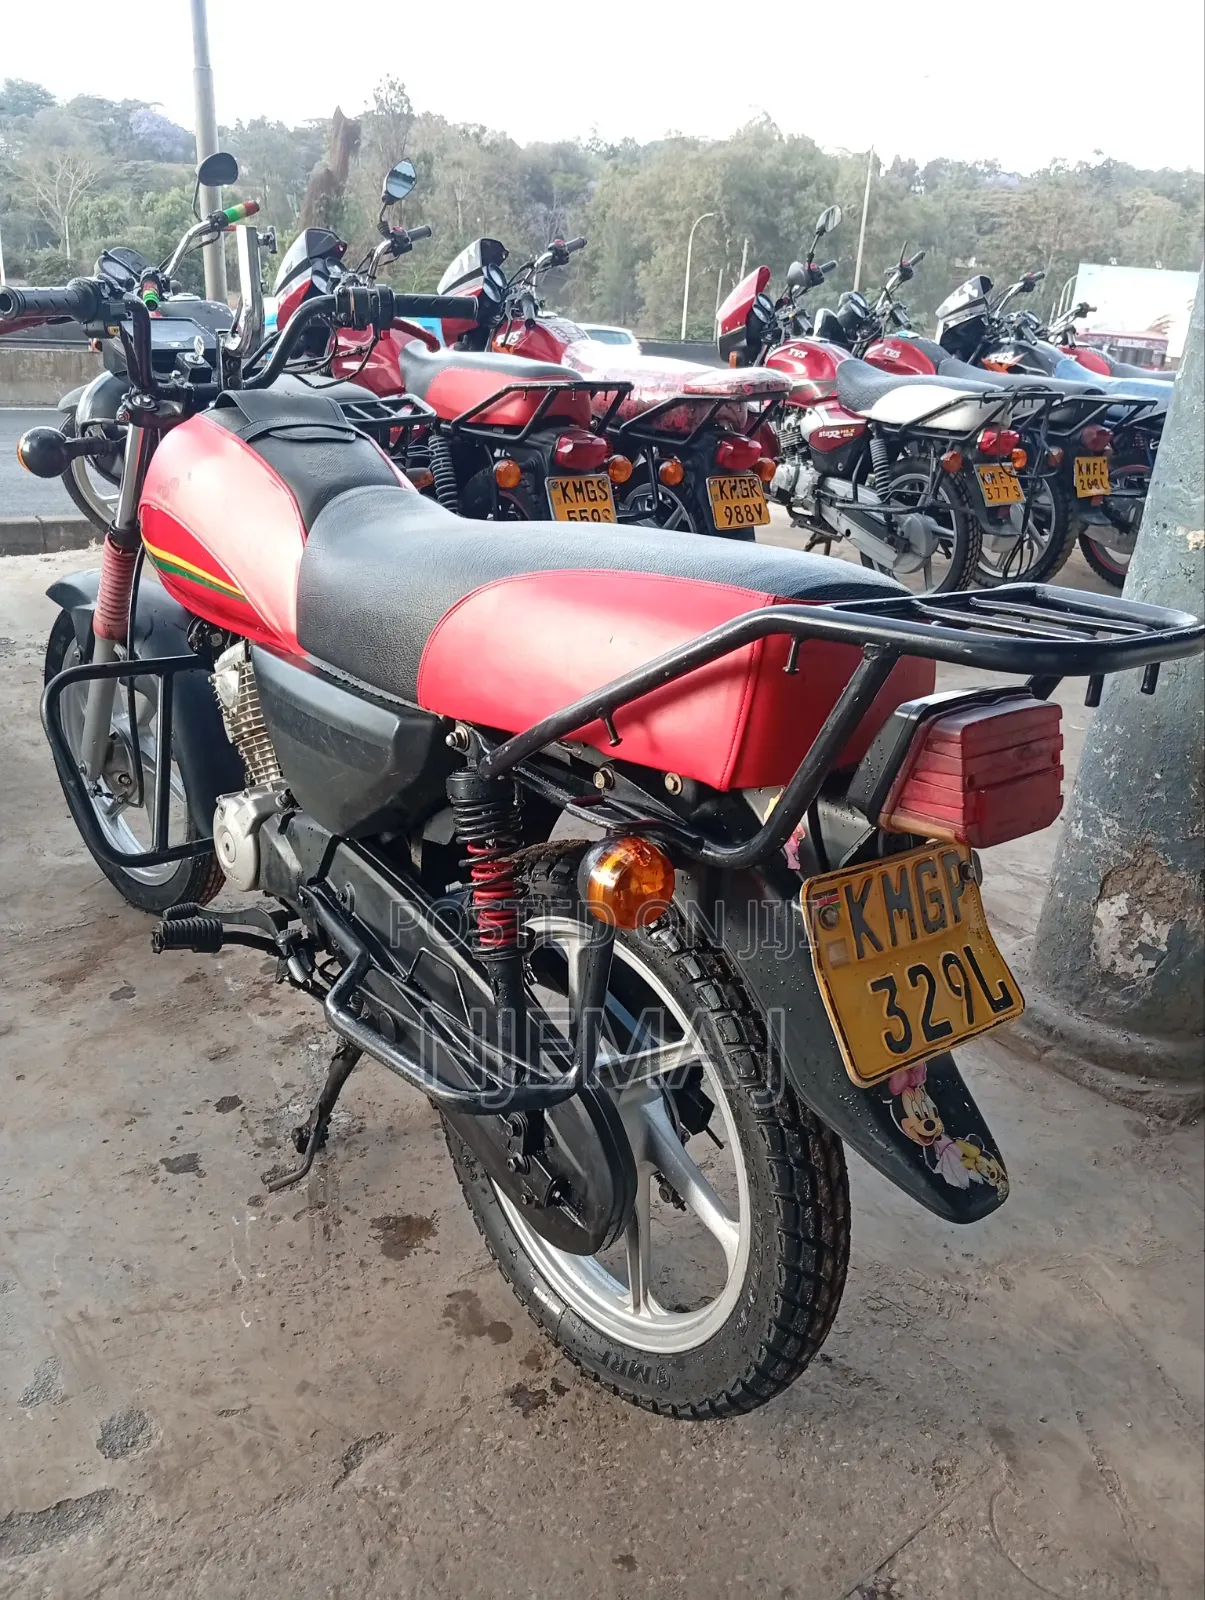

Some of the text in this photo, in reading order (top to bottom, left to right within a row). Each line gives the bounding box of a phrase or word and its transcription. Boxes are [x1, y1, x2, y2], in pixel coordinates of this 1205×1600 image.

[788, 348, 808, 359] TVS
[560, 479, 608, 503] KMGS
[718, 478, 760, 500] KMGR
[985, 486, 1021, 500] 377S
[724, 503, 762, 526] 988Y
[844, 852, 967, 960] KMGP
[870, 945, 1014, 1055] 329L
